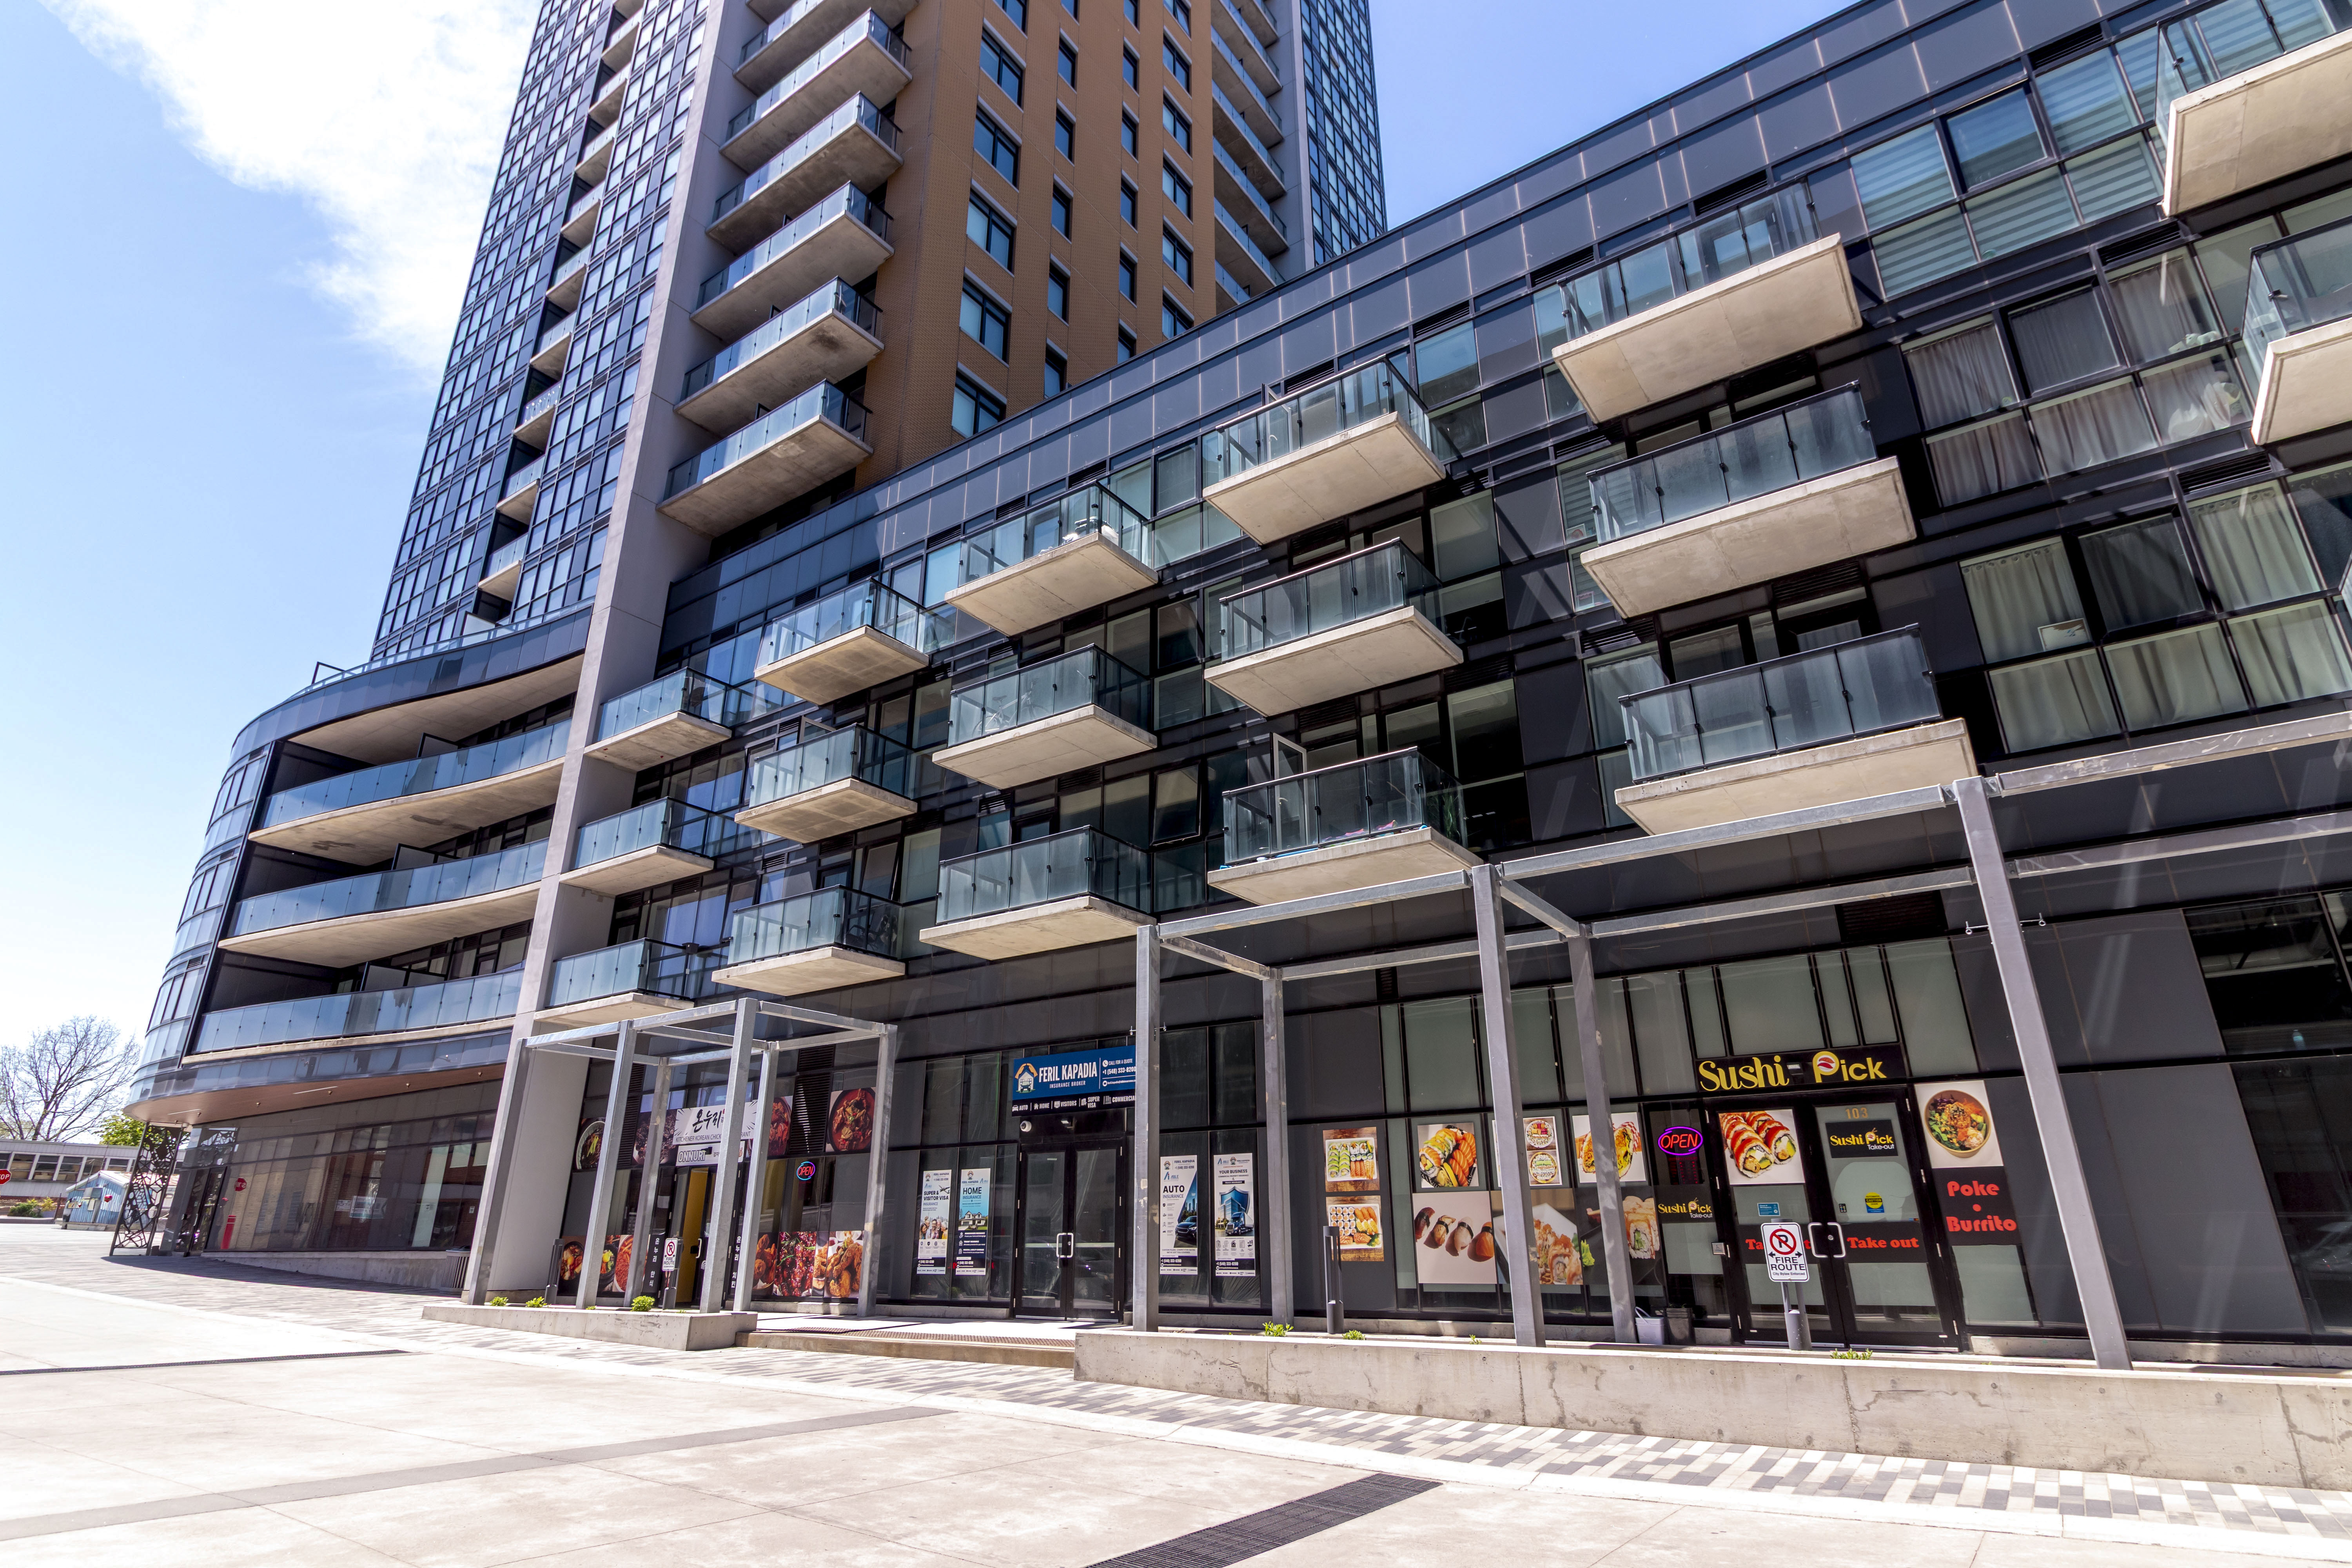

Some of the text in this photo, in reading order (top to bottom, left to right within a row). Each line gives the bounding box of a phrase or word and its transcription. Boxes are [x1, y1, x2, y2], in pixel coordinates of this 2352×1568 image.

[1039, 1062, 1097, 1082] FERIL KAPADIA
[1699, 1051, 1887, 1091] Sushi Pick
[1846, 1107, 1868, 1119] 103
[693, 1109, 722, 1133] 온누리
[1661, 1134, 1698, 1148] OPEN
[1830, 1132, 1894, 1146] Sushi Pick
[679, 1149, 705, 1162] ONNURI
[798, 1167, 813, 1176] OPEN
[1947, 1181, 1999, 1196] Poke
[1658, 1201, 1712, 1213] Sushi Pick
[1946, 1215, 2017, 1232] Burrito
[1745, 1239, 1764, 1250] Ta
[1847, 1237, 1919, 1248] Take out
